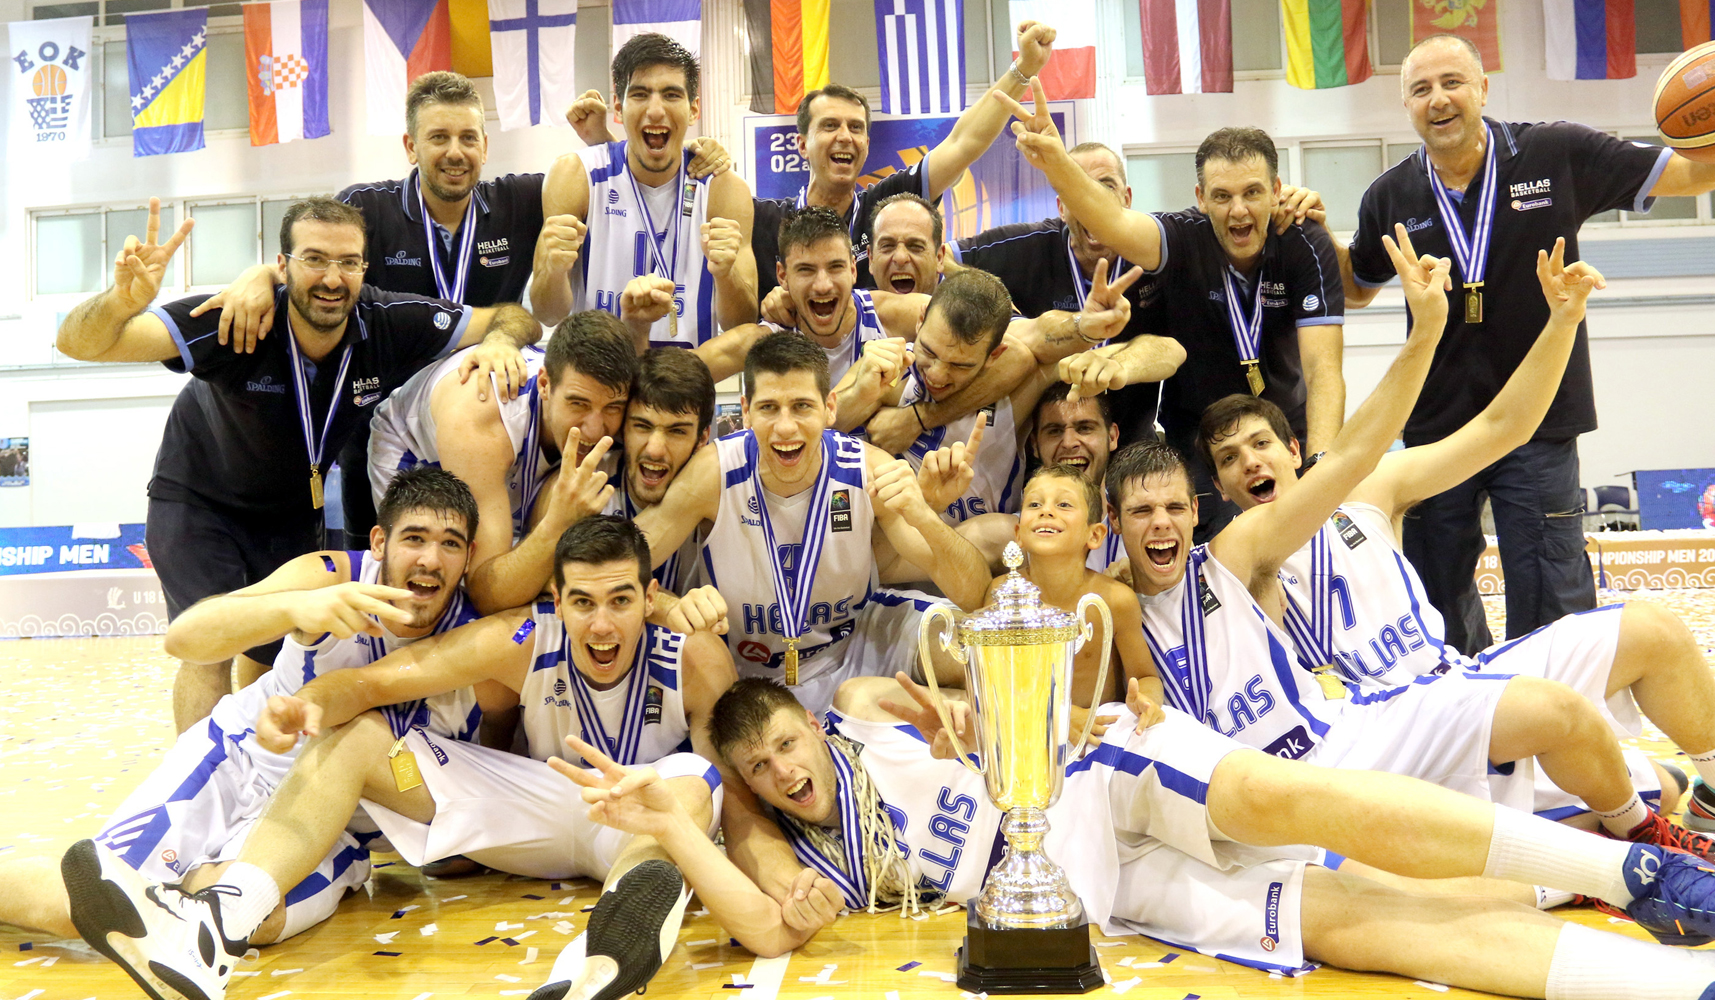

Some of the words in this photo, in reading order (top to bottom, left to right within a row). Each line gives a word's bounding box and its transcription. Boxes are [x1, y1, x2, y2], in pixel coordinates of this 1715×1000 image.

[36, 131, 66, 143] 1970
[770, 132, 799, 151] 23
[1510, 178, 1551, 193] HELLAS
[1511, 187, 1551, 198] BASKETBALL
[1522, 199, 1550, 209] Eurobank
[1406, 218, 1433, 232] ALDING
[477, 238, 508, 250] HELLAS
[385, 256, 421, 267] SPALDING
[246, 381, 286, 394] SPALDING
[741, 515, 763, 527] SPALD
[833, 513, 848, 522] FIBA
[1342, 527, 1358, 541] FIBA
[59, 544, 110, 564] MEN
[1667, 549, 1696, 563] MEN
[143, 590, 155, 604] 18
[645, 707, 660, 715] FIBA
[1206, 674, 1276, 738] LAS
[1267, 886, 1280, 935] Eurobank
